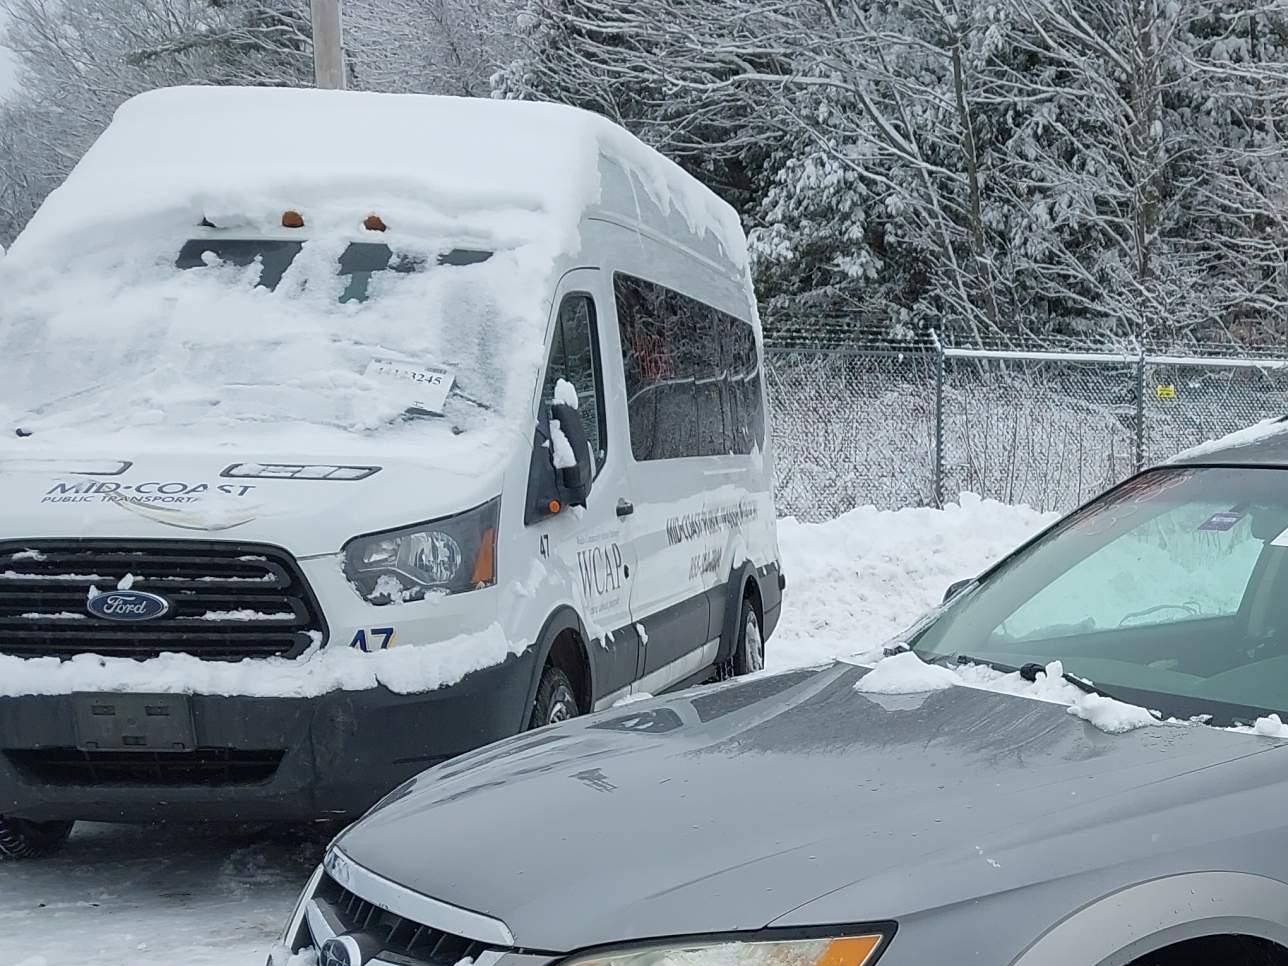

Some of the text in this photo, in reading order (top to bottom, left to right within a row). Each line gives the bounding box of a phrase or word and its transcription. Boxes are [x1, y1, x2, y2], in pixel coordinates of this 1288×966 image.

[41, 495, 95, 504] PUBLIC
[540, 534, 549, 560] 47
[577, 543, 622, 600] WCAP
[103, 595, 147, 614] Ford
